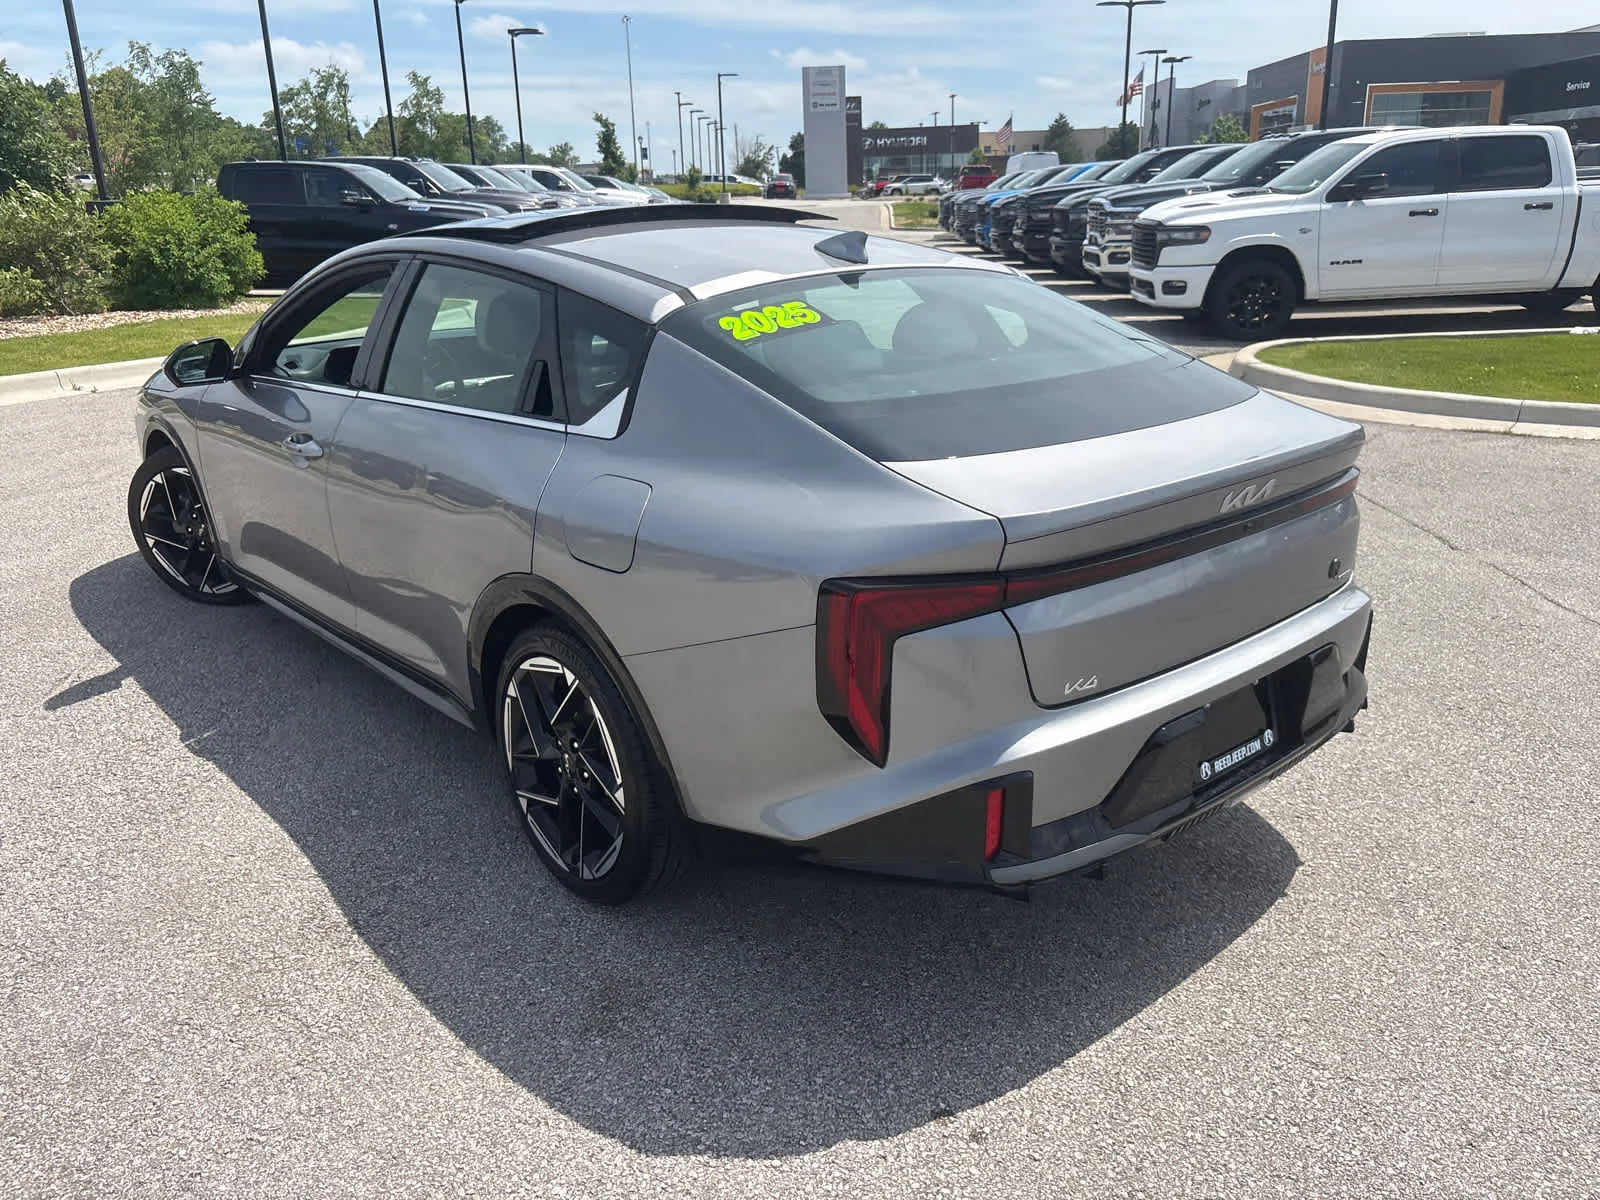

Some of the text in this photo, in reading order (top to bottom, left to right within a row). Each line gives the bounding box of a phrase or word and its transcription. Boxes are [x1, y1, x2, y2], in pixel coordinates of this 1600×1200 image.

[1566, 80, 1590, 91] Service
[877, 136, 927, 148] HYUNDAI
[719, 301, 821, 341] 2025
[1064, 675, 1097, 696] K4
[1214, 738, 1261, 773] REEDJEEP.COM
